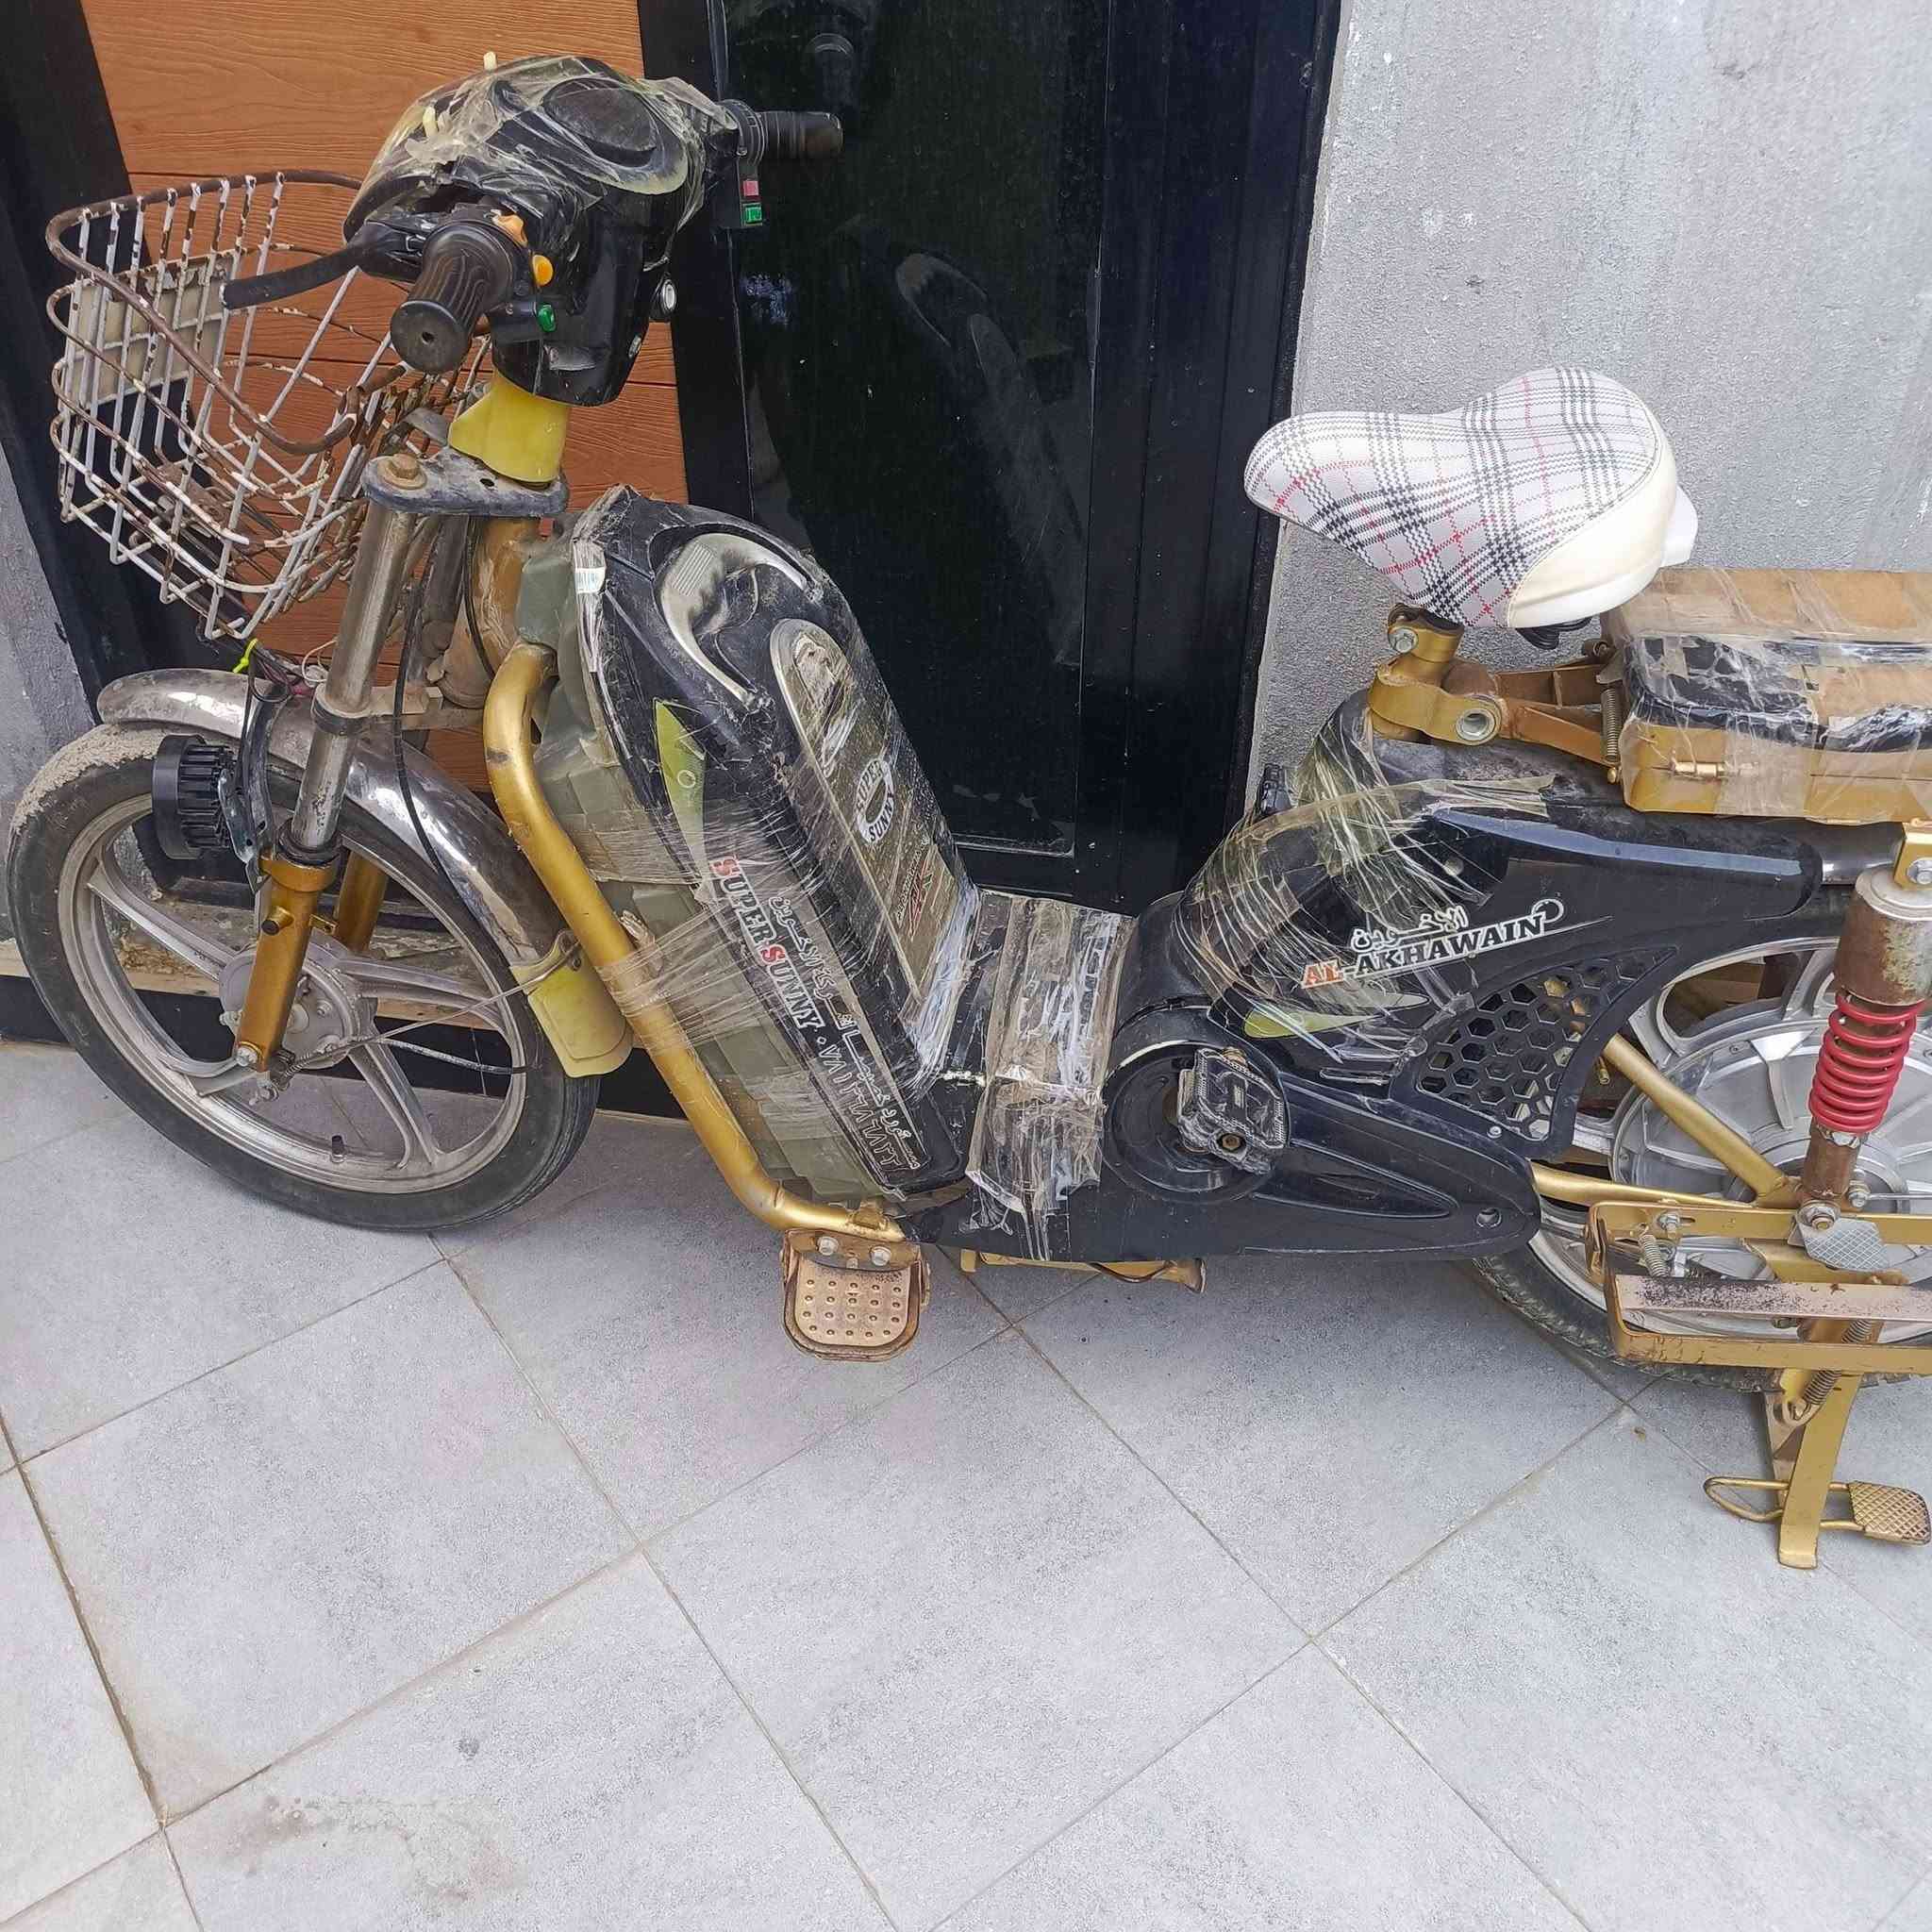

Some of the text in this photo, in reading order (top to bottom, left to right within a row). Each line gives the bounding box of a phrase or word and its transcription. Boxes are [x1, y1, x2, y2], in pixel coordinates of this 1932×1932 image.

[868, 785, 893, 841] SUNNY
[709, 858, 825, 1028] SUPER SUNNY
[768, 896, 826, 967] الاخوين
